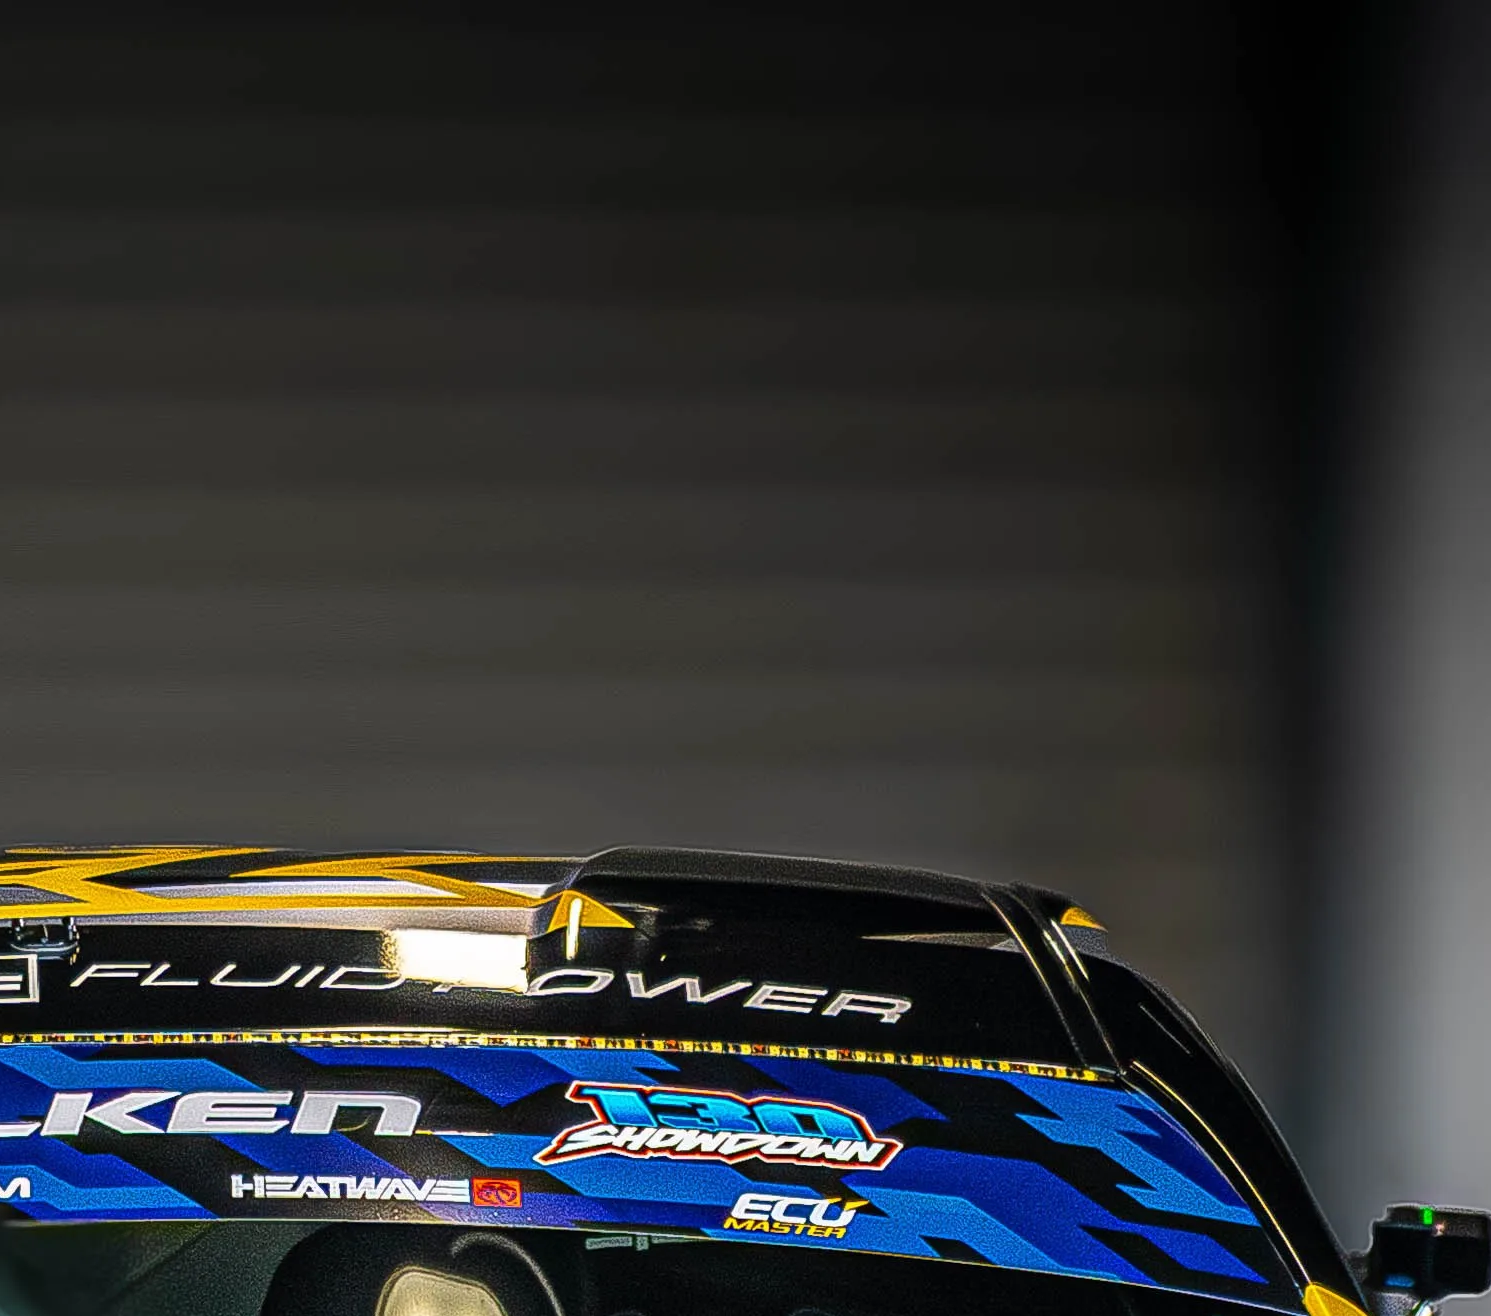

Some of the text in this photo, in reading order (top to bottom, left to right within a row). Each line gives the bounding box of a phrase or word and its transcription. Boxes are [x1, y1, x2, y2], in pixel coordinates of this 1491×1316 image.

[71, 962, 405, 990] FLUID
[433, 967, 913, 1024] OWER
[580, 1087, 864, 1141] 130
[558, 1125, 886, 1162] SHOWDOWN
[231, 1174, 471, 1205] HEATWAVE
[723, 1217, 847, 1239] MASTER
[730, 1192, 865, 1228] ECU
